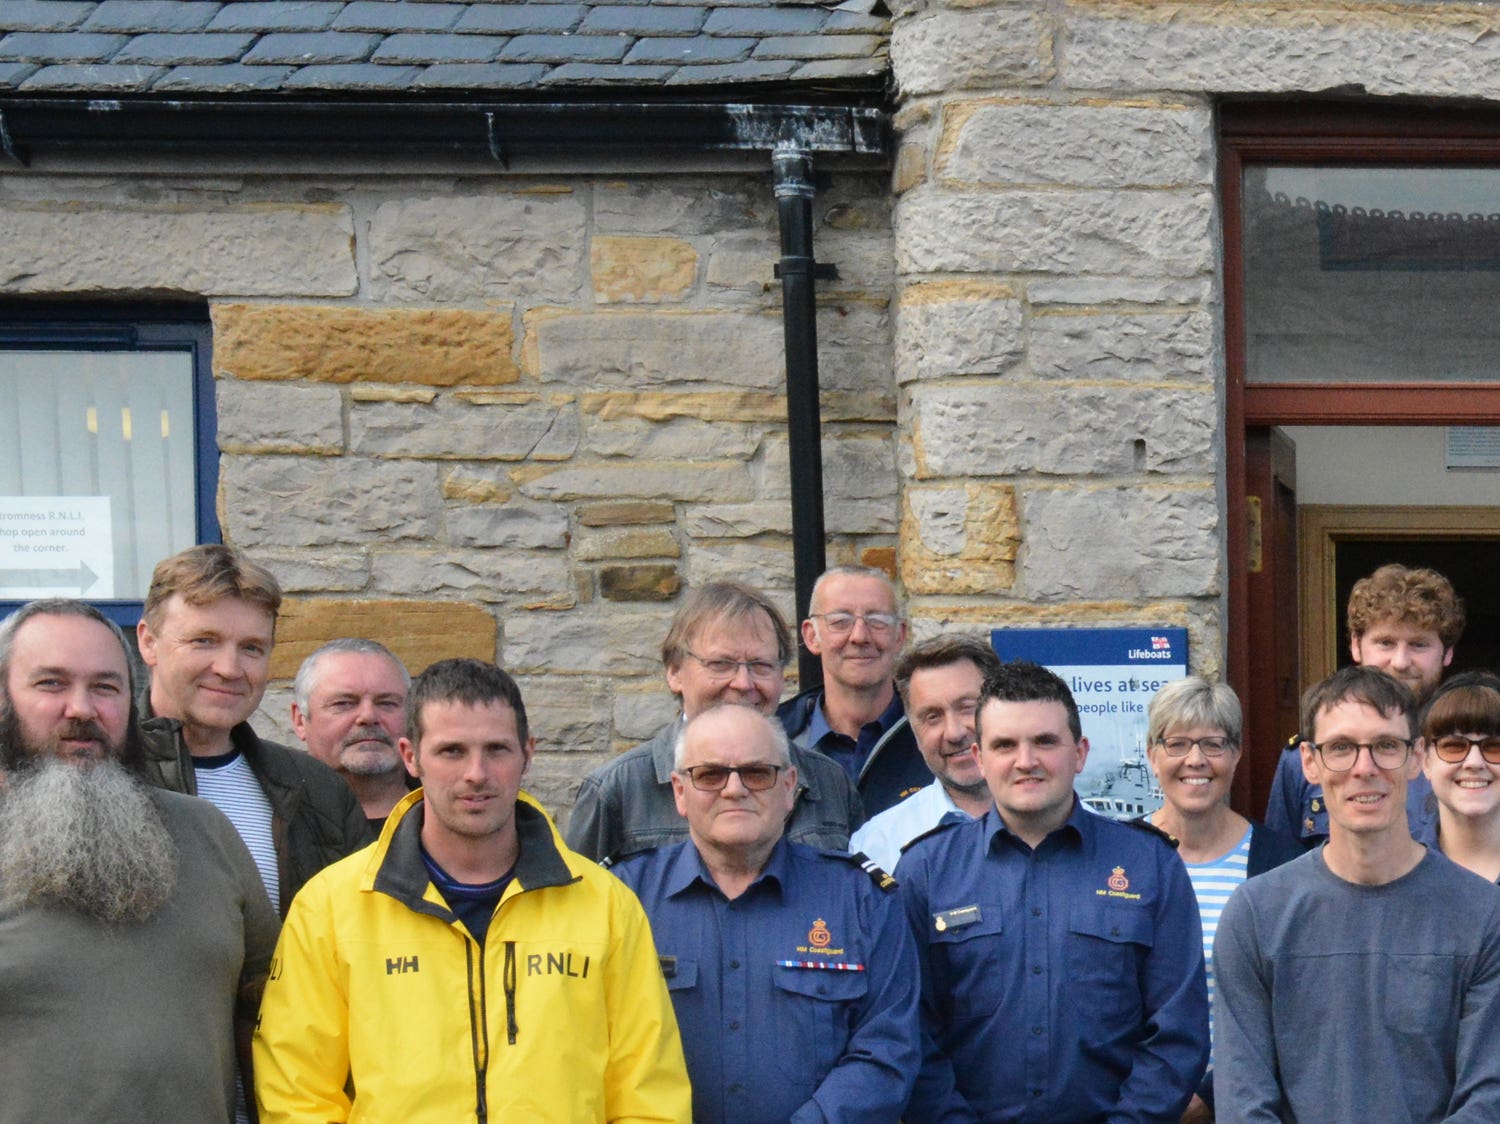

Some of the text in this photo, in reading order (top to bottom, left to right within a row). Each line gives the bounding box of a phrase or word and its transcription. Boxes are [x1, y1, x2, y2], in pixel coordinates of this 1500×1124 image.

[0, 511, 46, 521] tromness
[0, 527, 86, 538] hop open around
[13, 544, 31, 553] the
[1128, 648, 1172, 660] Lifeboats
[1072, 676, 1112, 693] lives
[1118, 677, 1136, 692] at
[1121, 701, 1144, 713] like
[386, 955, 419, 975] HH
[527, 952, 590, 979] RNLI
